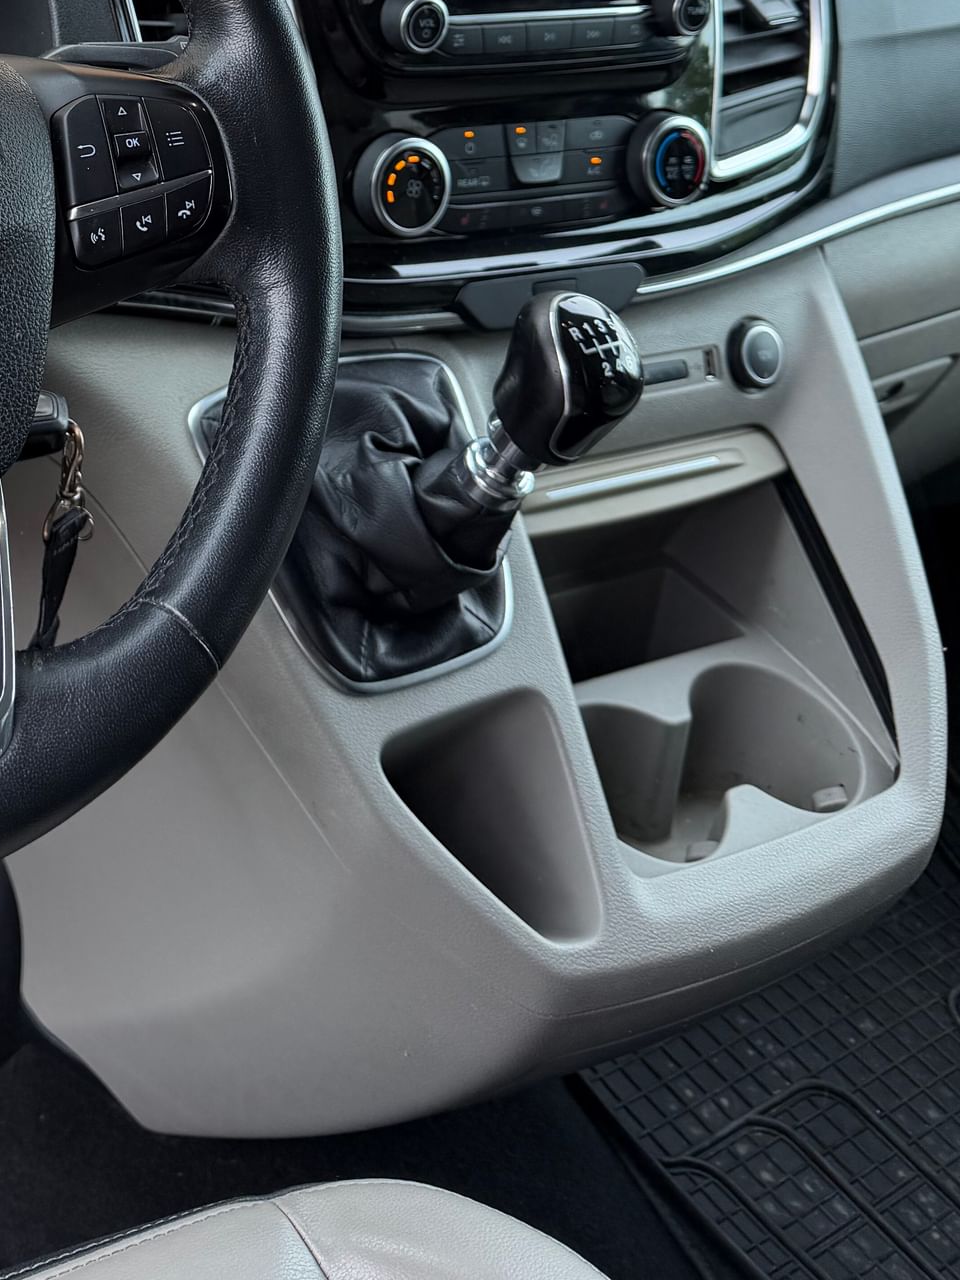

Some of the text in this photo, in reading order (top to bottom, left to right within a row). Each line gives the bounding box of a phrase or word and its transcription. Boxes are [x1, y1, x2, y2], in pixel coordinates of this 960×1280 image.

[124, 135, 141, 149] OK
[568, 327, 584, 341] R
[582, 322, 595, 336] 1
[594, 319, 607, 333] 3
[602, 361, 614, 376] 2
